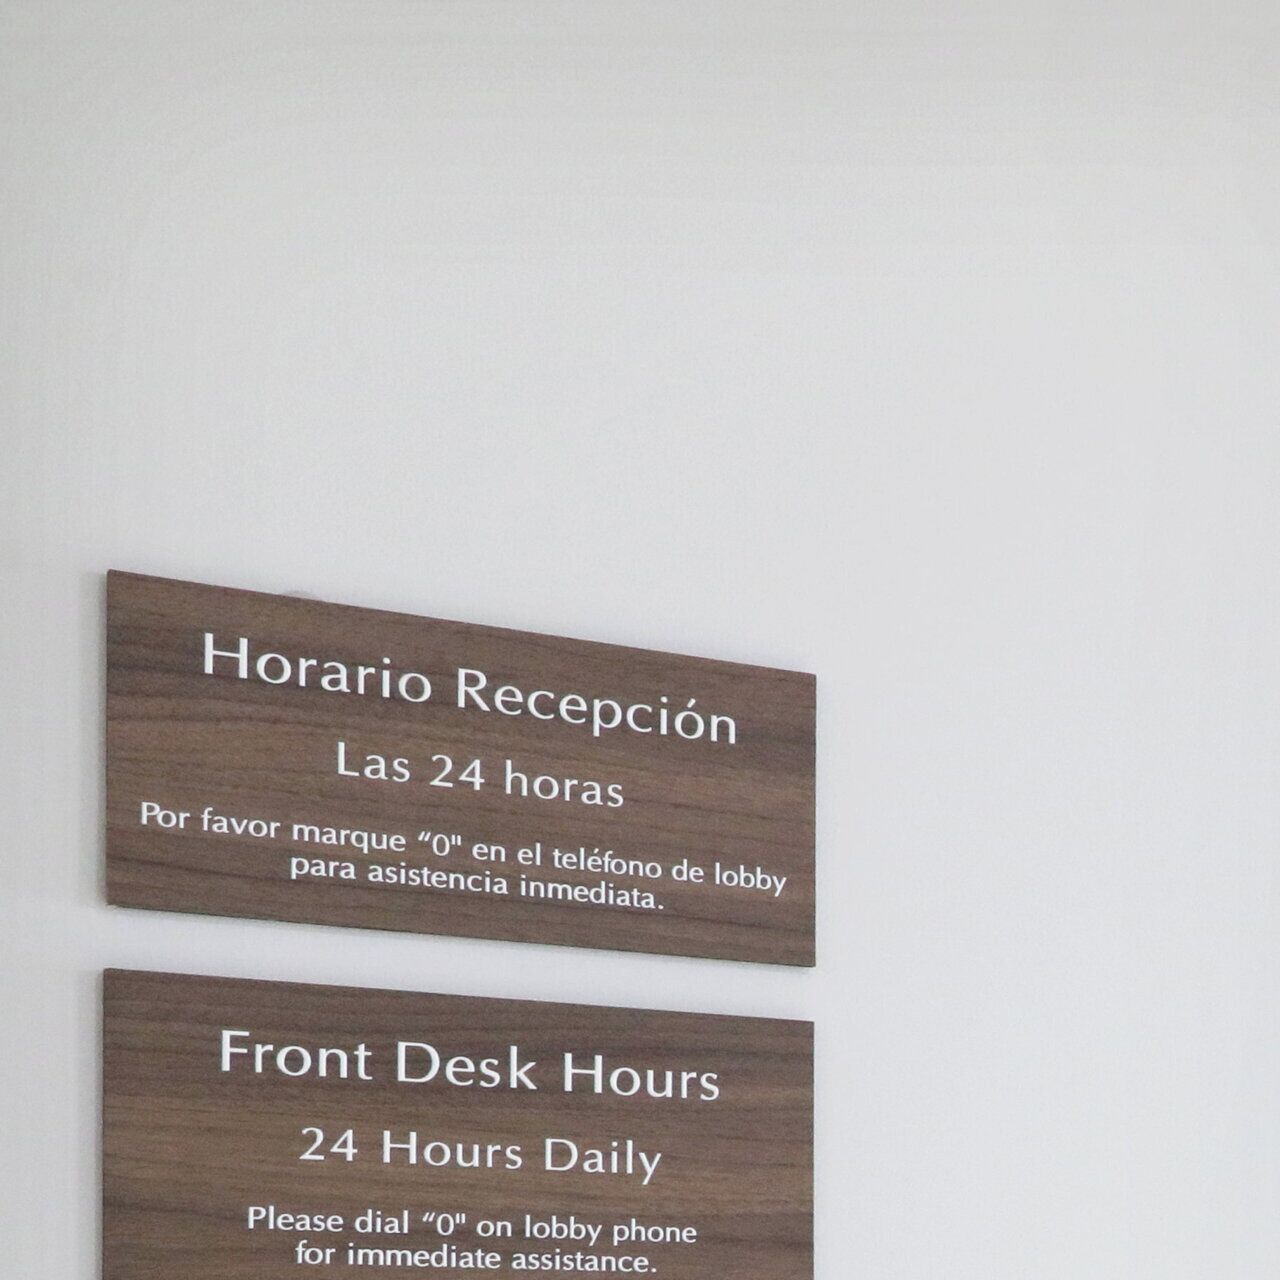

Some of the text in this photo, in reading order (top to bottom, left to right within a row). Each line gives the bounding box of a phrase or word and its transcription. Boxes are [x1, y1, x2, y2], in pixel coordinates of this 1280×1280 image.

[204, 632, 736, 745] Horario Recepción
[337, 741, 624, 808] Las 24 horas
[141, 801, 191, 829] Por
[201, 806, 281, 838] favor
[292, 824, 407, 854] marque
[472, 843, 506, 862] en
[517, 842, 541, 866] el
[552, 847, 663, 879] teléfono
[671, 858, 705, 883] de
[715, 862, 787, 898] lobby
[291, 857, 664, 910] para asistencia inmediata.
[221, 1029, 720, 1101] Front Desk Hours
[299, 1127, 662, 1186] 24 Hours Daily
[248, 1205, 344, 1232] Please
[354, 1208, 409, 1234] dial
[476, 1220, 512, 1237] on
[524, 1214, 603, 1247] lobby
[612, 1220, 697, 1248] phone
[295, 1239, 657, 1273] for immediate assistance.
